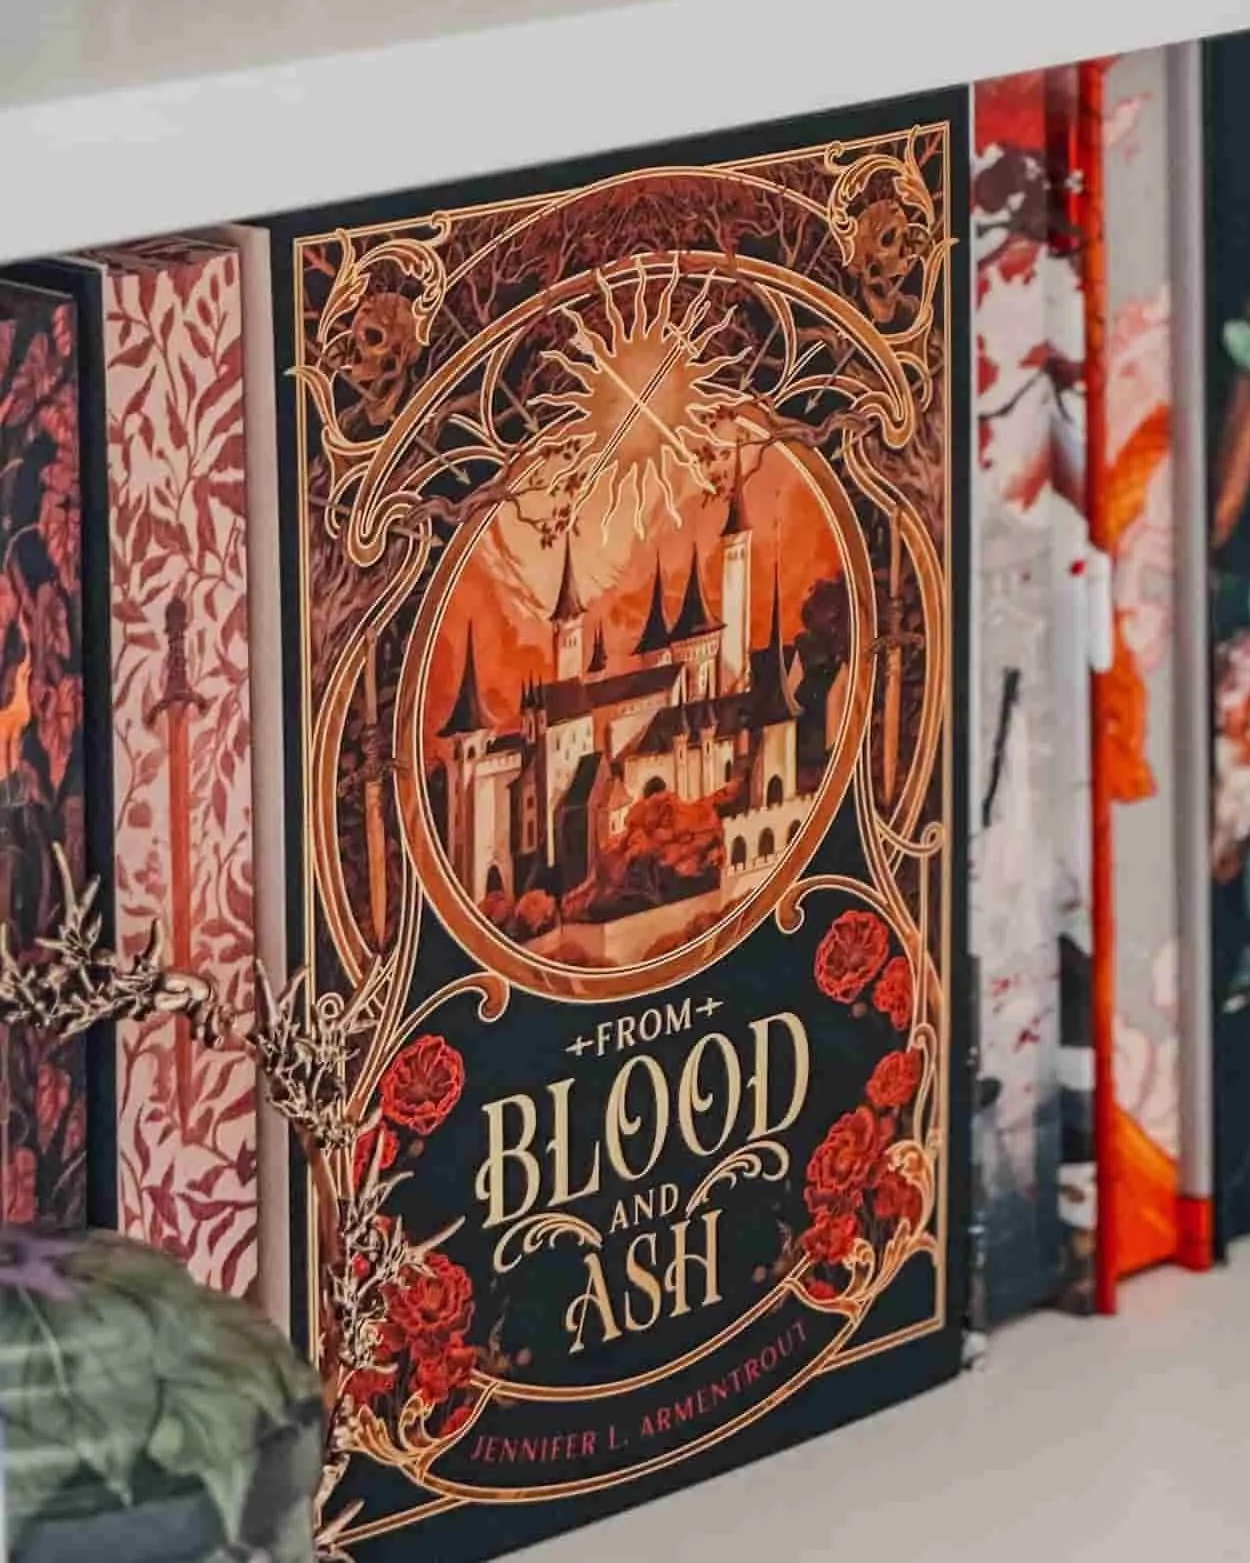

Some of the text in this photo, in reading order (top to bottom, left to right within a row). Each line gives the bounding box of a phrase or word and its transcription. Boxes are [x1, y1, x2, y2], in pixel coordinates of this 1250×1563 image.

[595, 998, 693, 1056] FROM
[474, 1011, 810, 1229] BLOOD
[609, 1183, 680, 1234] AND
[565, 1206, 724, 1355] ASH
[470, 1320, 808, 1463] JENNIFER L. ARMENTROUT
